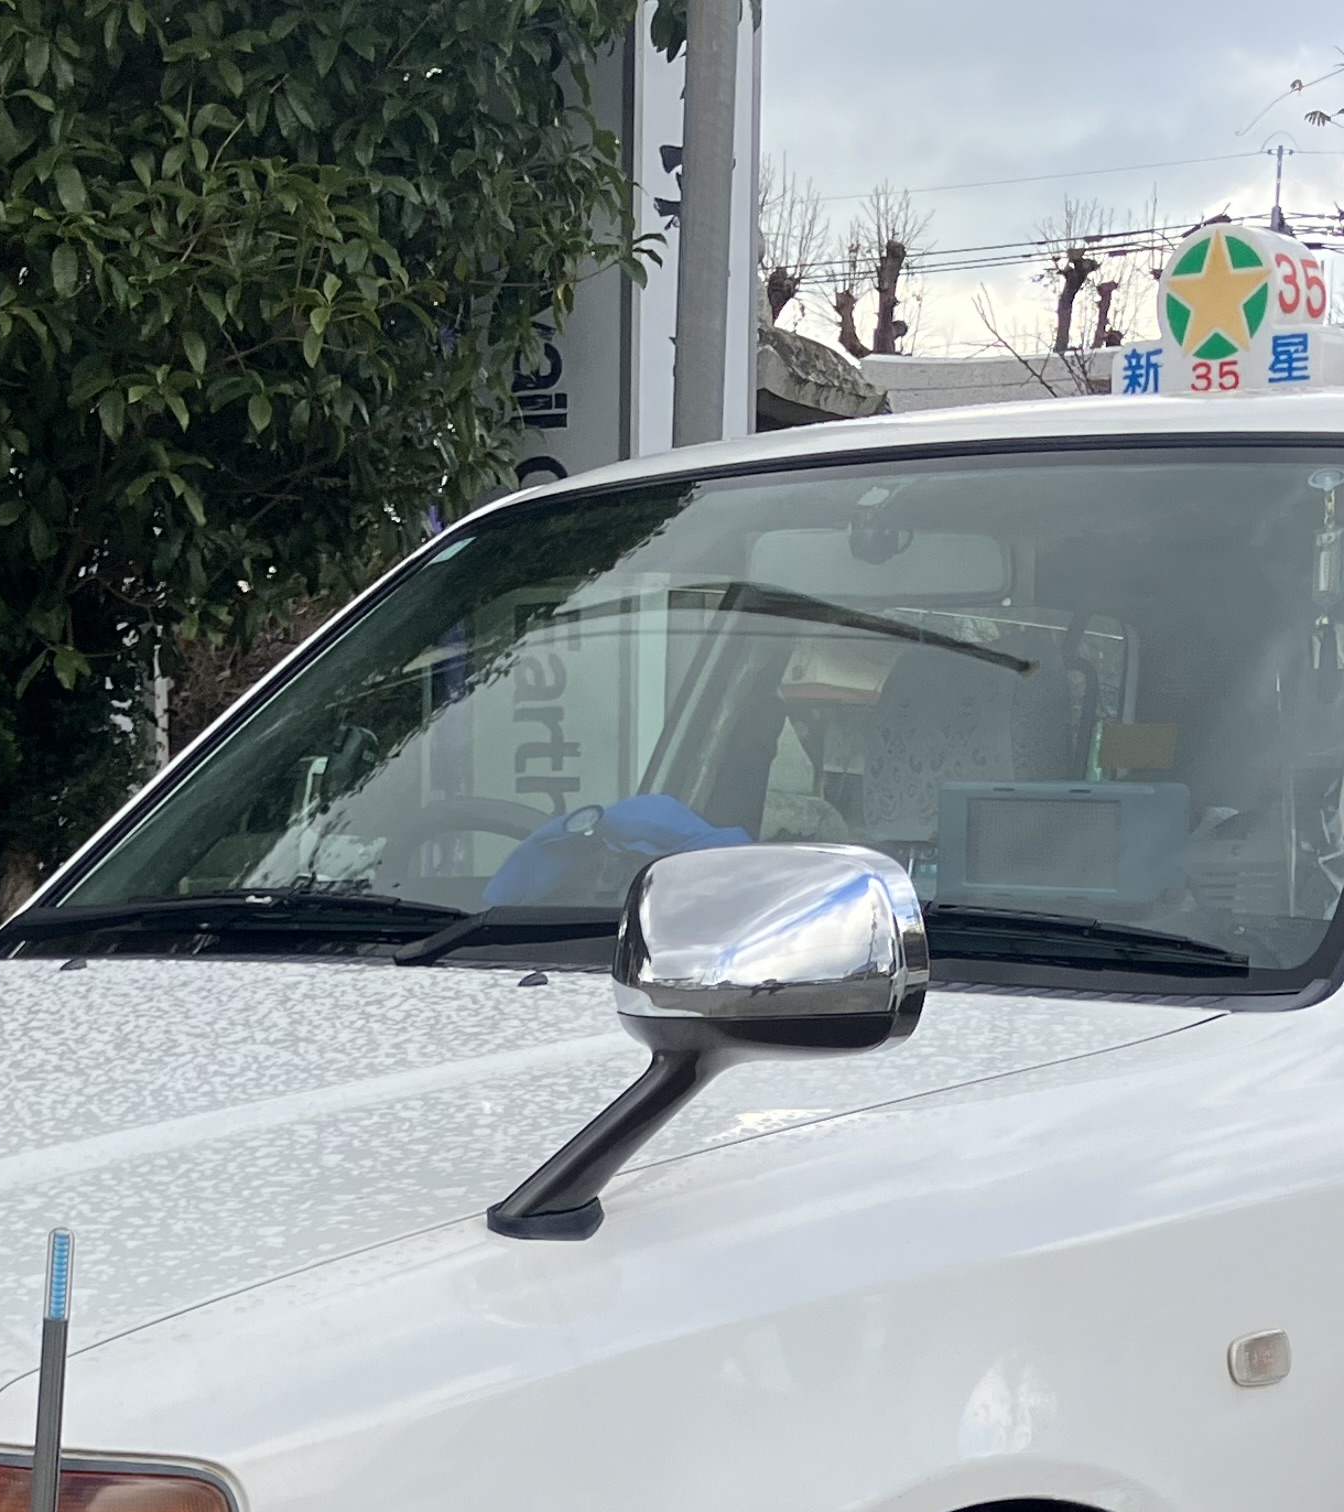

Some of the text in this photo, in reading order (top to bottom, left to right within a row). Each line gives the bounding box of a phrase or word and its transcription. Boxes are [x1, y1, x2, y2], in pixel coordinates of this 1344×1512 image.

[1274, 251, 1327, 319] 35
[1122, 332, 1311, 394] 新 35 星
[512, 602, 582, 816] Earth
